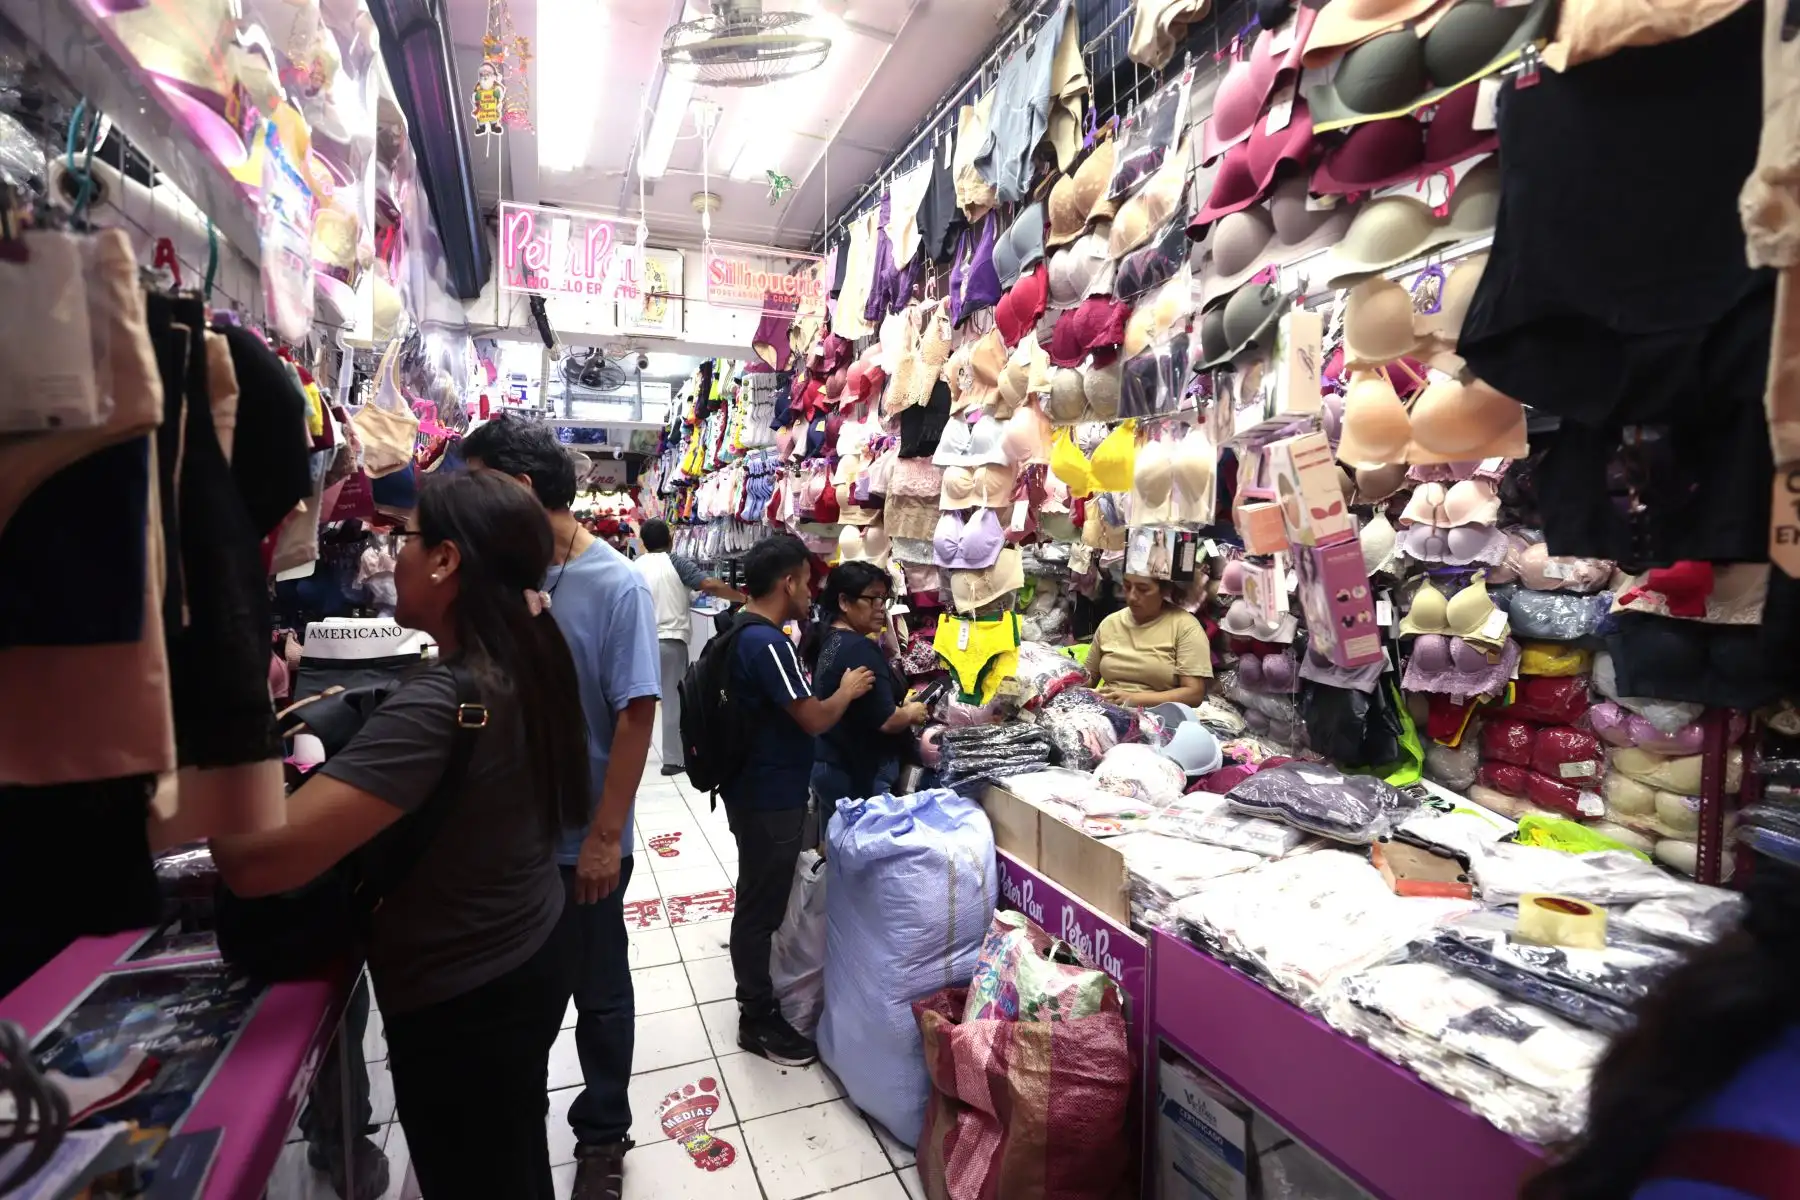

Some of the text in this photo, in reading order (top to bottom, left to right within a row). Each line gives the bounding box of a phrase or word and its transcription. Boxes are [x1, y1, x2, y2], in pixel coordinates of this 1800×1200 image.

[504, 209, 583, 276] Petr
[507, 273, 524, 287] LA
[527, 277, 583, 294] MOLO
[709, 258, 824, 297] Silhouette
[308, 626, 402, 640] AMERICANO
[998, 861, 1044, 924] Peter Pan
[1061, 904, 1124, 981] Peter Pan
[662, 1106, 713, 1129] MEDIAS
